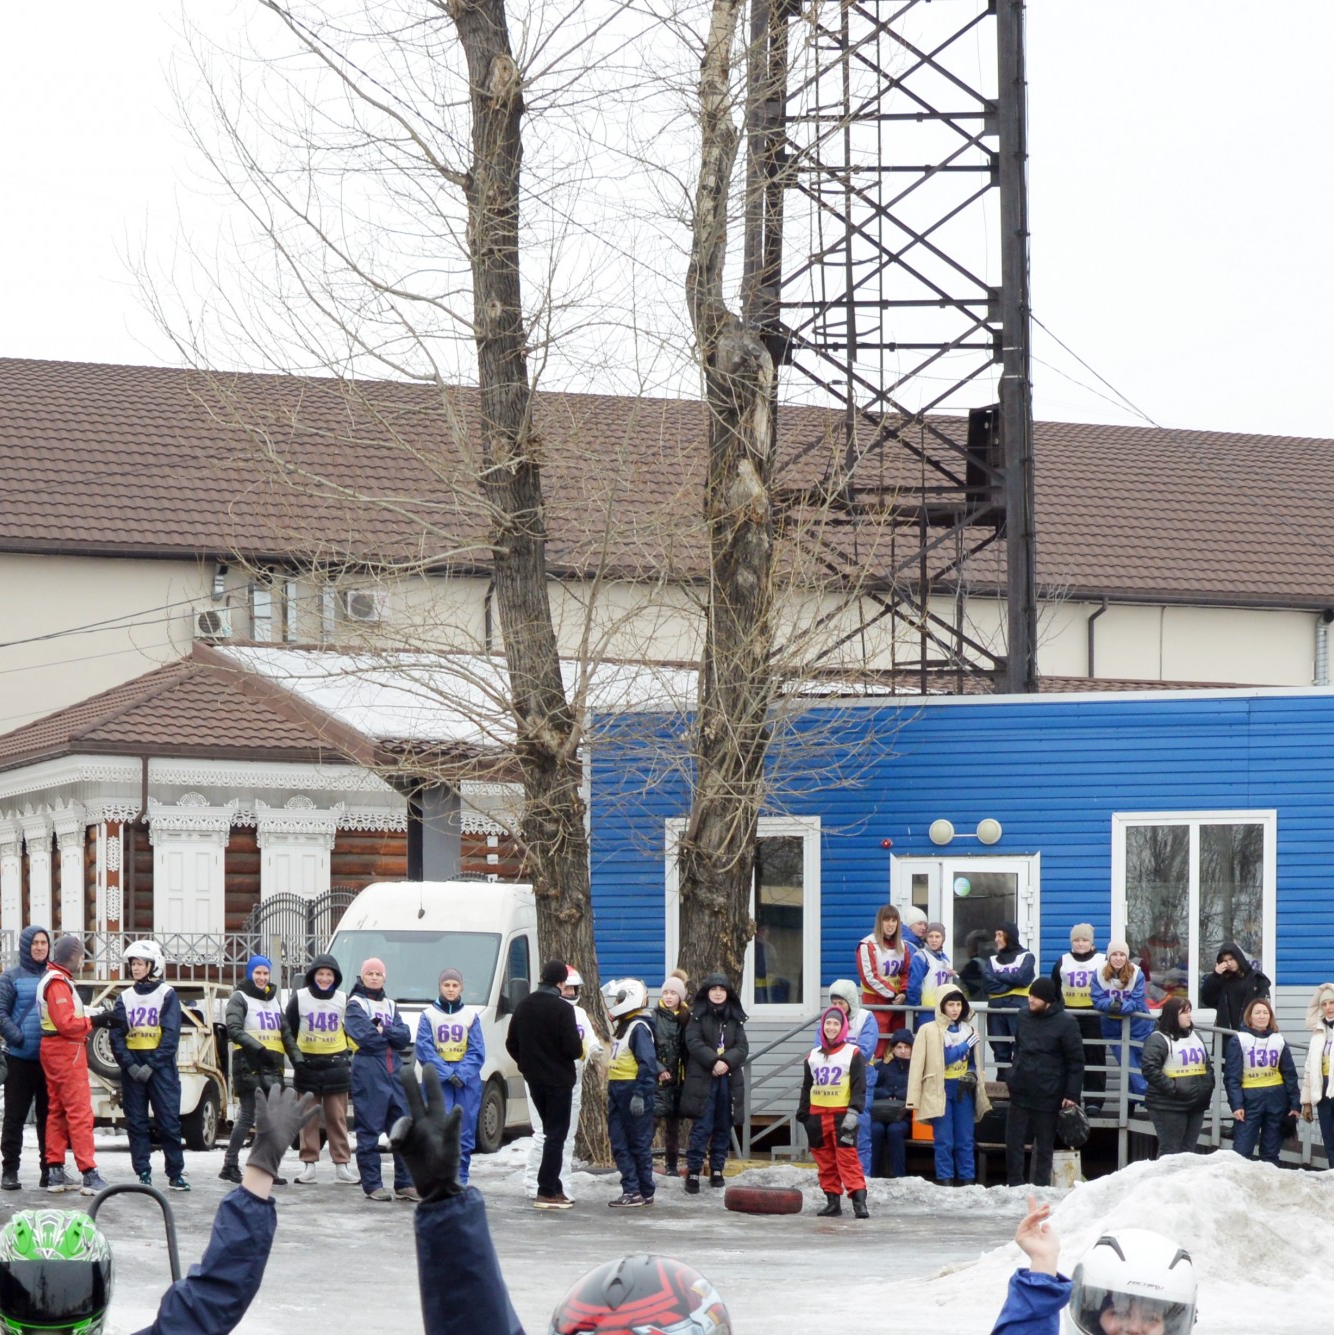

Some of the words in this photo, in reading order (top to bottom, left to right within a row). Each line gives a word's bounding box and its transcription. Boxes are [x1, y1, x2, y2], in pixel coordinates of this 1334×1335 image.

[128, 1007, 158, 1028] 128
[307, 1012, 339, 1032] 148
[437, 1024, 464, 1043] 69
[1247, 1049, 1278, 1068] 138
[814, 1066, 843, 1086] 132
